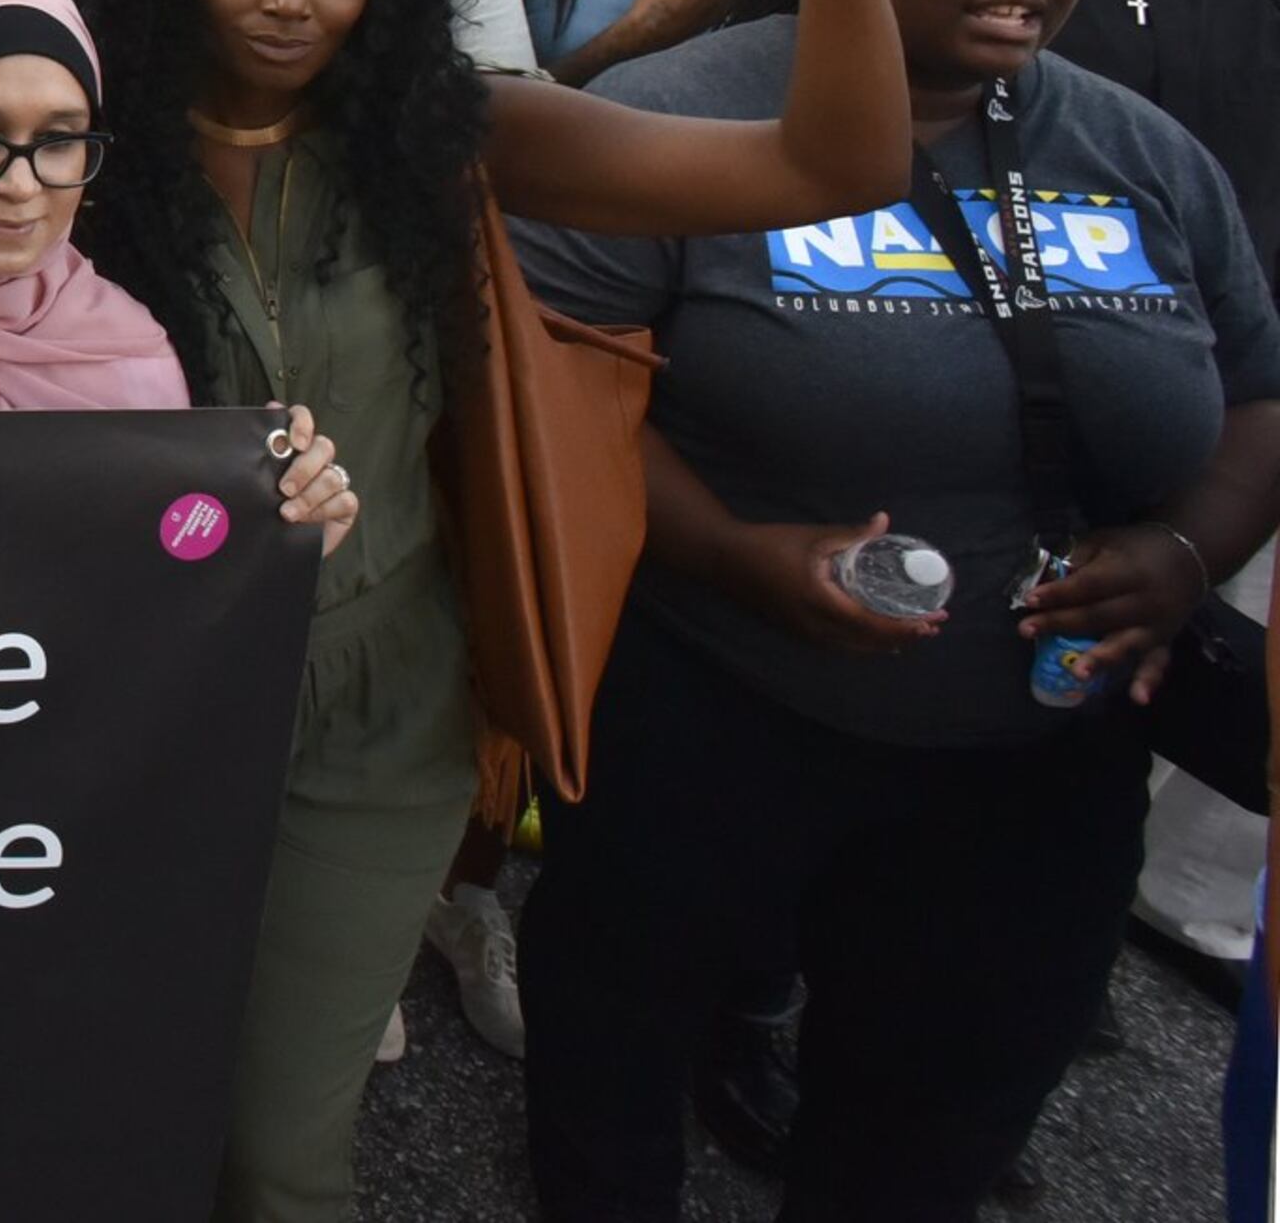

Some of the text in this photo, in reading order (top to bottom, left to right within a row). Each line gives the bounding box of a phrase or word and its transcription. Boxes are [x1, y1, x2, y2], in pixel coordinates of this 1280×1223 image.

[782, 207, 1130, 272] NACP
[1007, 170, 1041, 282] FALCONS
[775, 295, 913, 316] COLUMBUS
